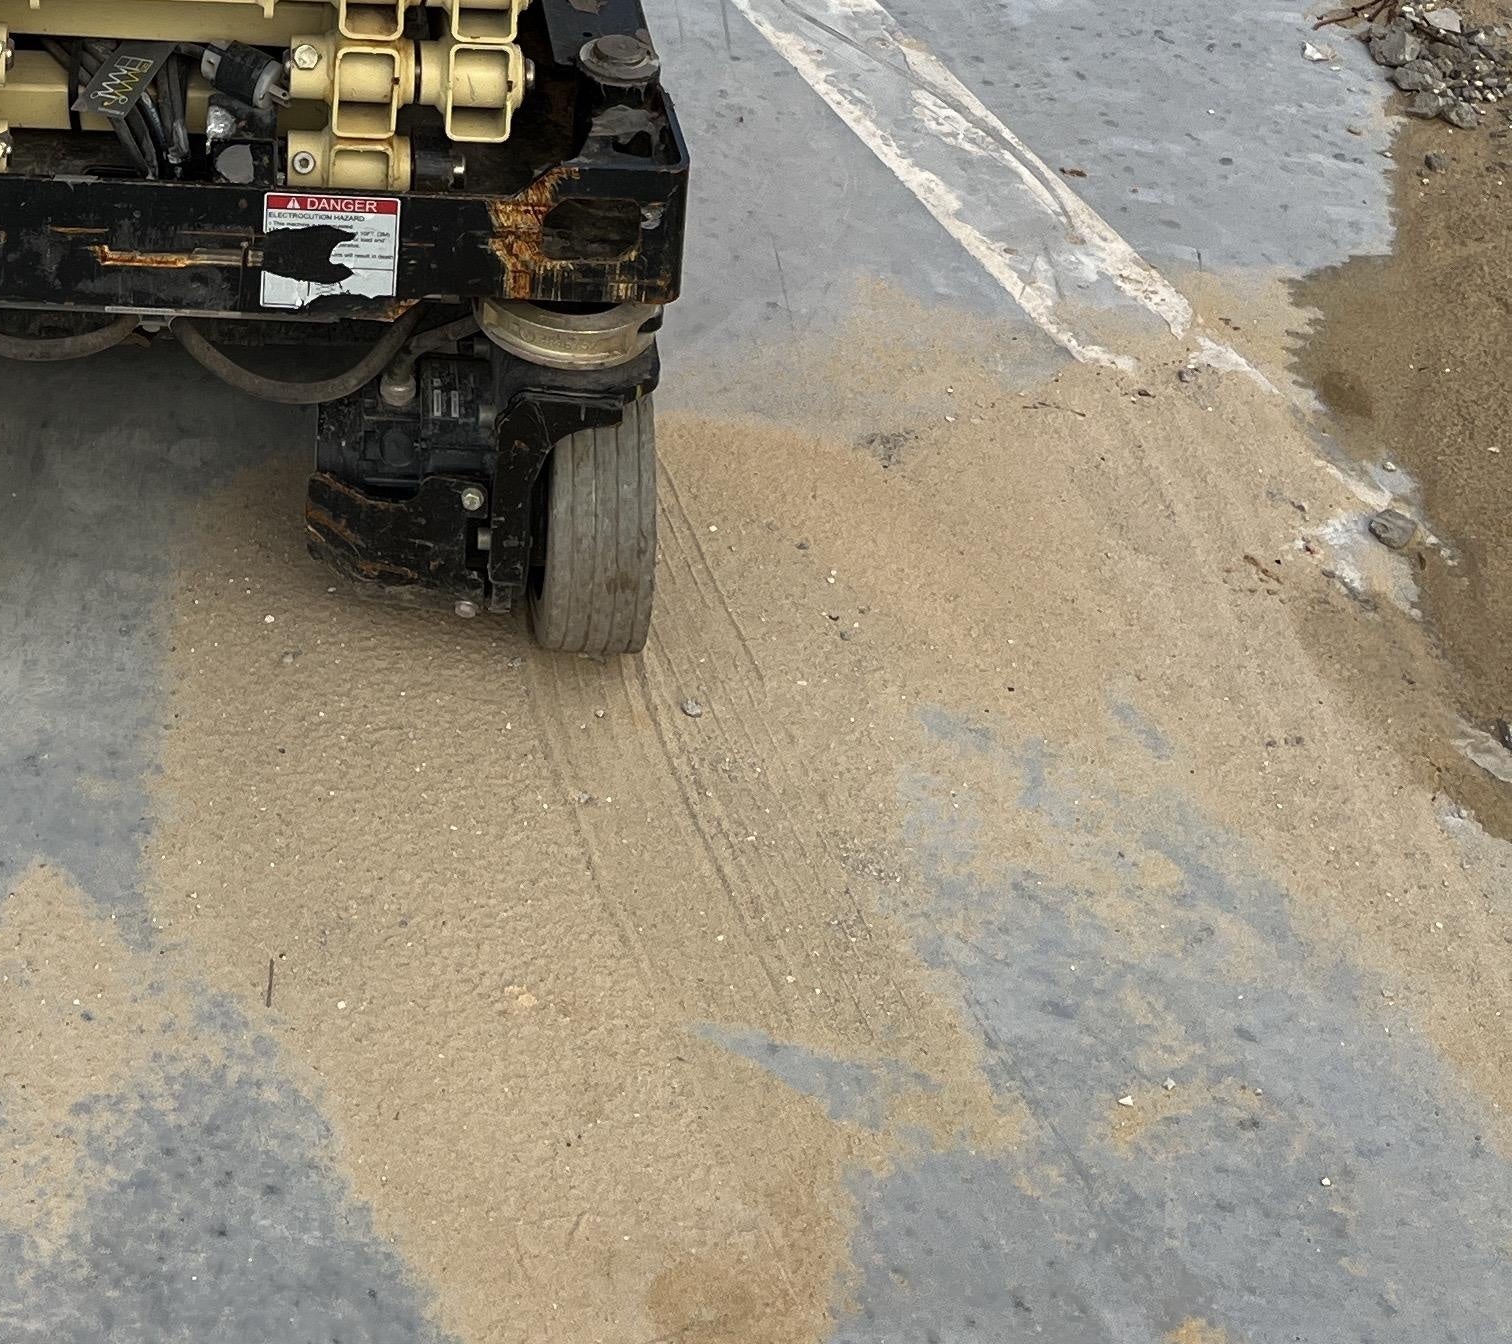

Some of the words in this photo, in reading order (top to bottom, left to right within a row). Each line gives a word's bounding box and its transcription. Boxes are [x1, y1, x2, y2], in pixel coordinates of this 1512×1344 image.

[306, 198, 377, 213] DANGER
[268, 211, 333, 221] ELECTROCUTION
[333, 214, 365, 222] HAZARD
